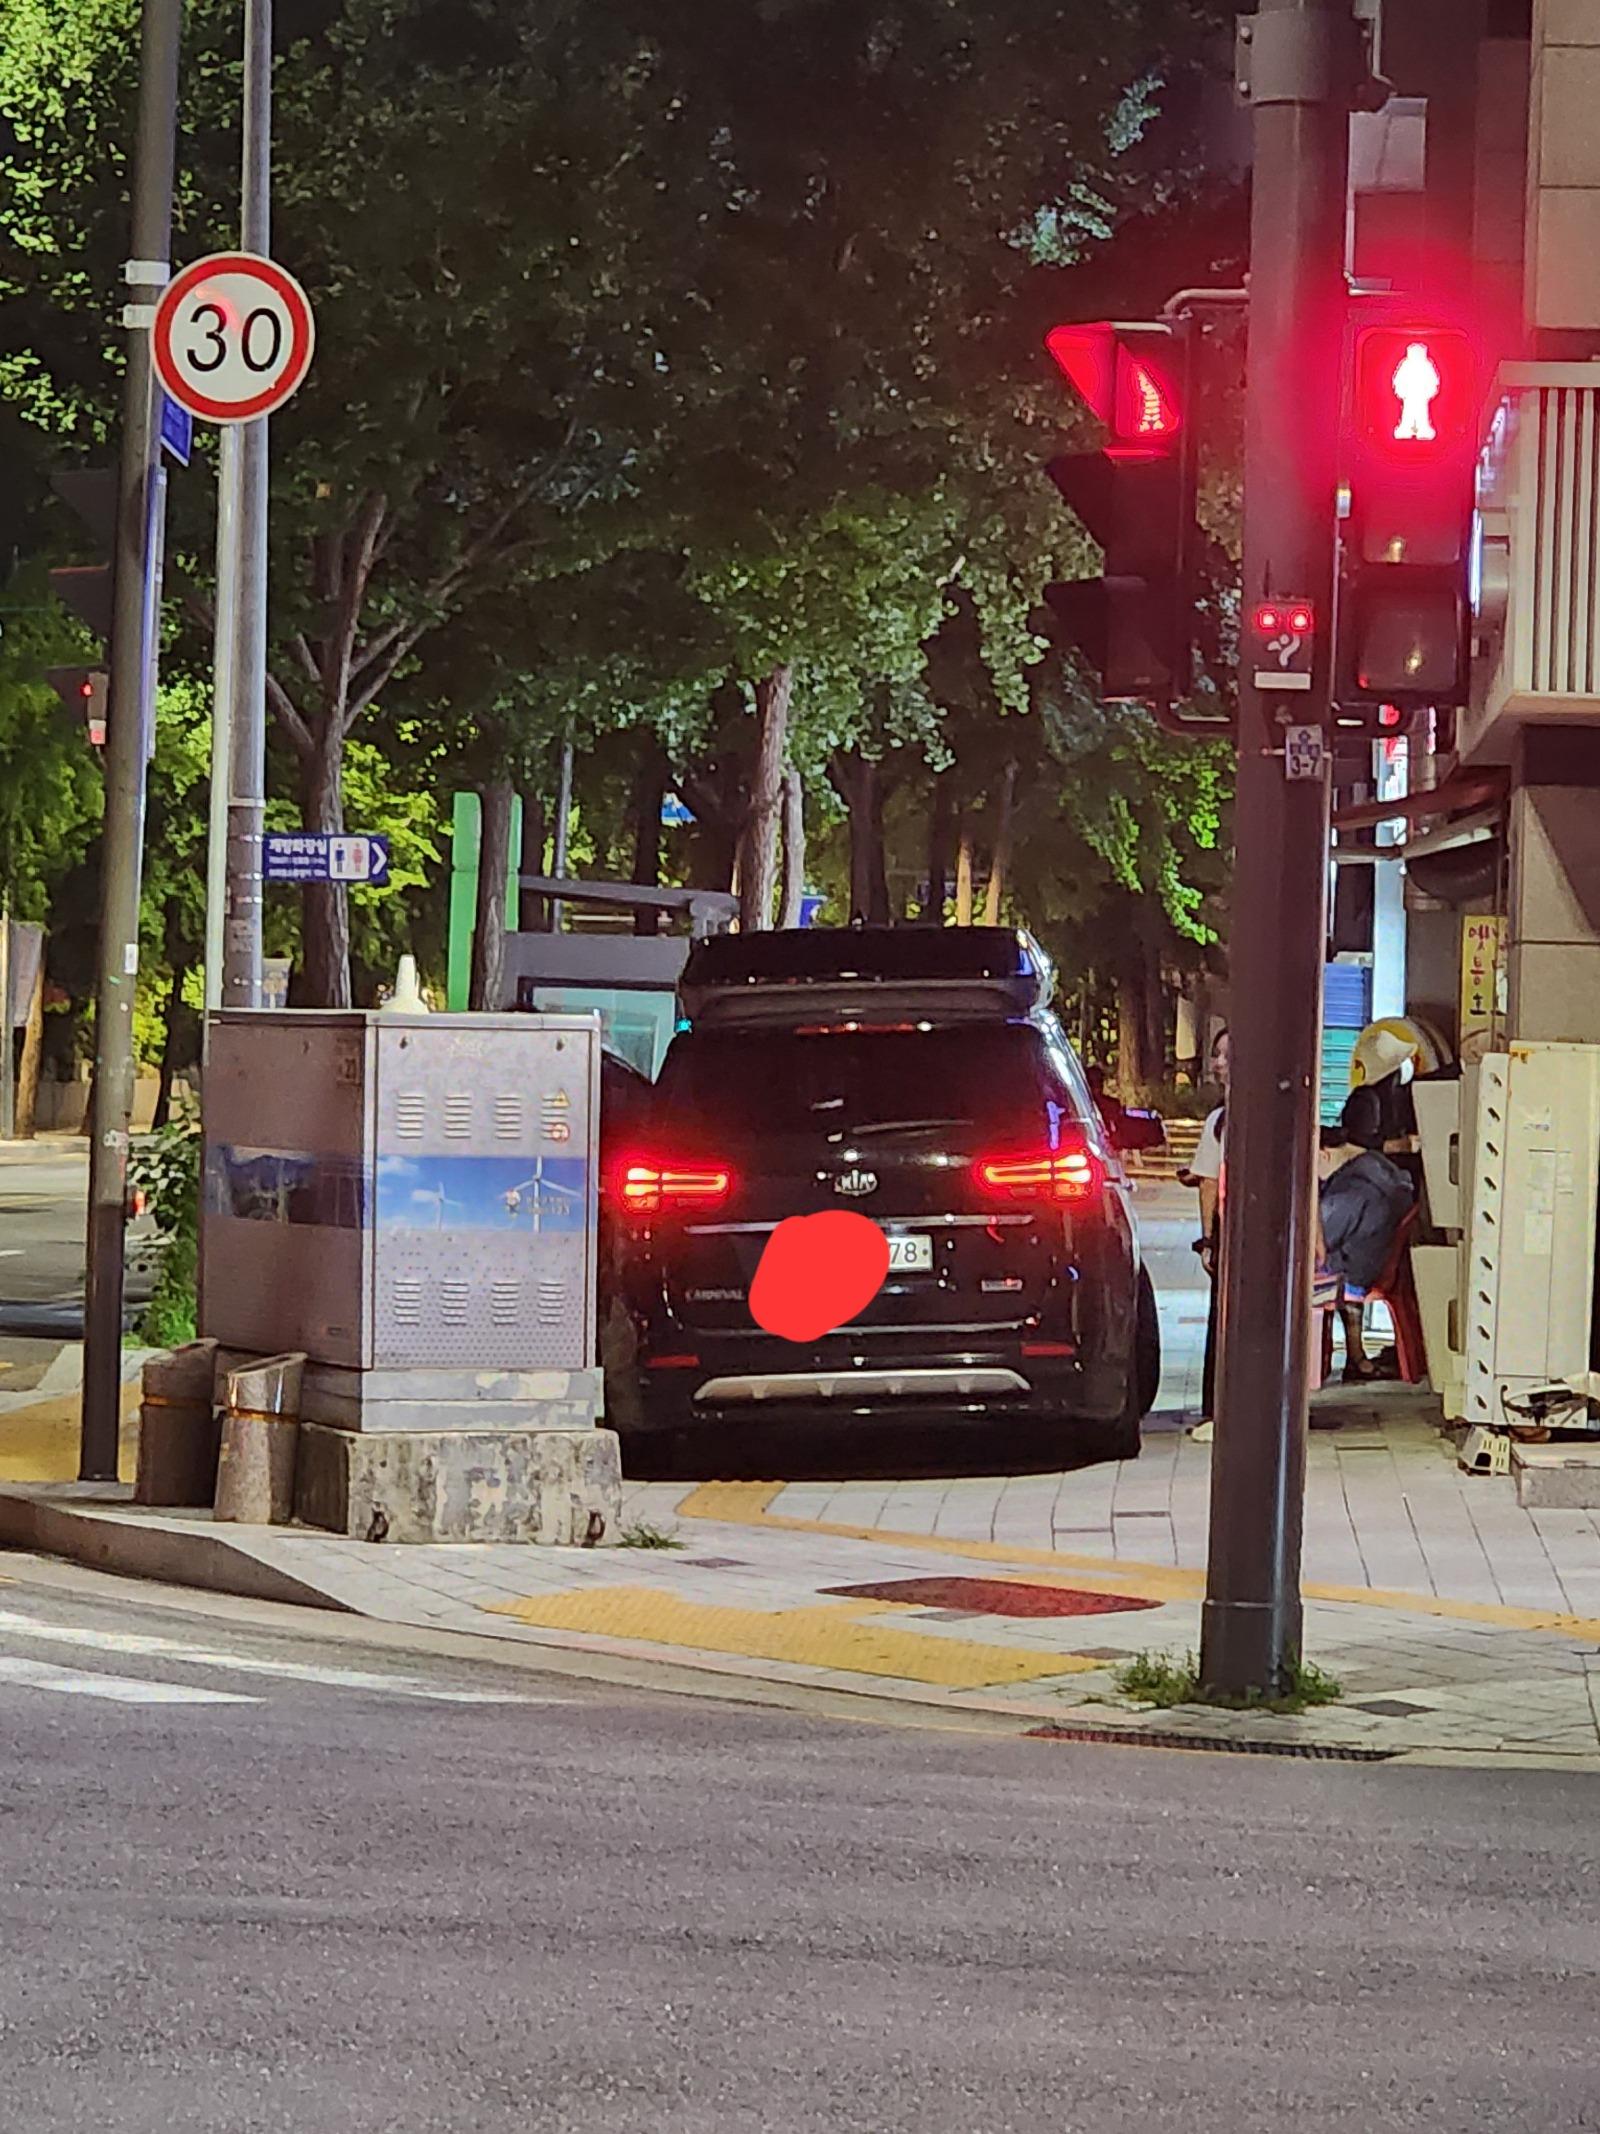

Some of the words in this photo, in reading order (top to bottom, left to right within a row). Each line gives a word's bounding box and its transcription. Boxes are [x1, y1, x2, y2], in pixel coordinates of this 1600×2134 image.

[187, 303, 282, 372] 30
[841, 1169, 876, 1191] KIA
[888, 1241, 918, 1264] 78
